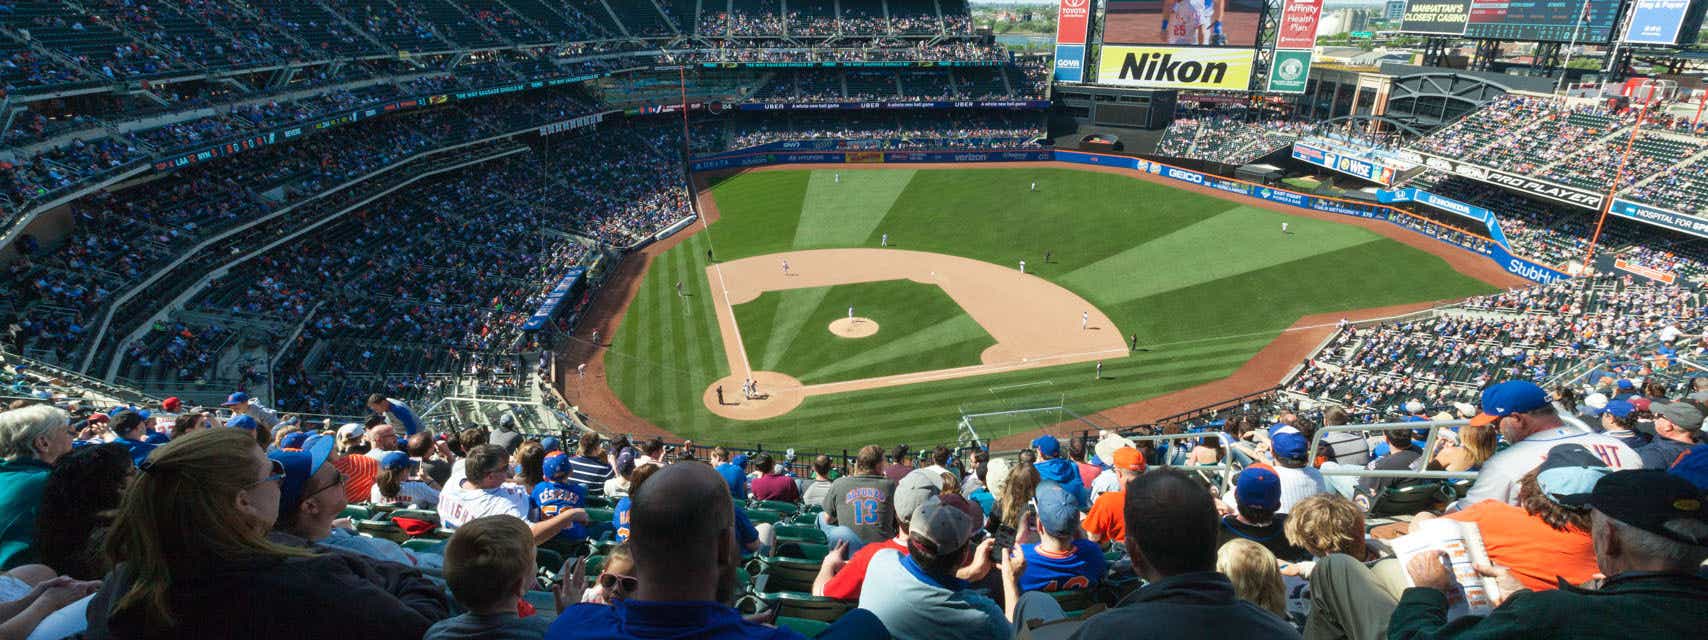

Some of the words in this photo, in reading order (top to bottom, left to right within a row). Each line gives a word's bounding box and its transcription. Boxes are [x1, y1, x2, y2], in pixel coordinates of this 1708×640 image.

[1287, 4, 1319, 14] Affinity
[1411, 4, 1463, 13] MANHATTAN'S
[1288, 15, 1314, 24] Health
[1404, 13, 1436, 22] CLOSEST
[1438, 14, 1467, 23] CASINO
[1290, 23, 1308, 31] Plan
[1118, 52, 1228, 84] Nikon
[954, 153, 986, 161] verizon
[1168, 168, 1203, 184] GEICO
[1349, 159, 1371, 178] WISE
[1487, 172, 1525, 187] PRO
[1523, 181, 1600, 206] PLAYER
[1436, 196, 1471, 214] HONDA
[1637, 208, 1674, 225] HOSPITAL
[1674, 218, 1692, 228] FOR
[853, 499, 879, 526] 13
